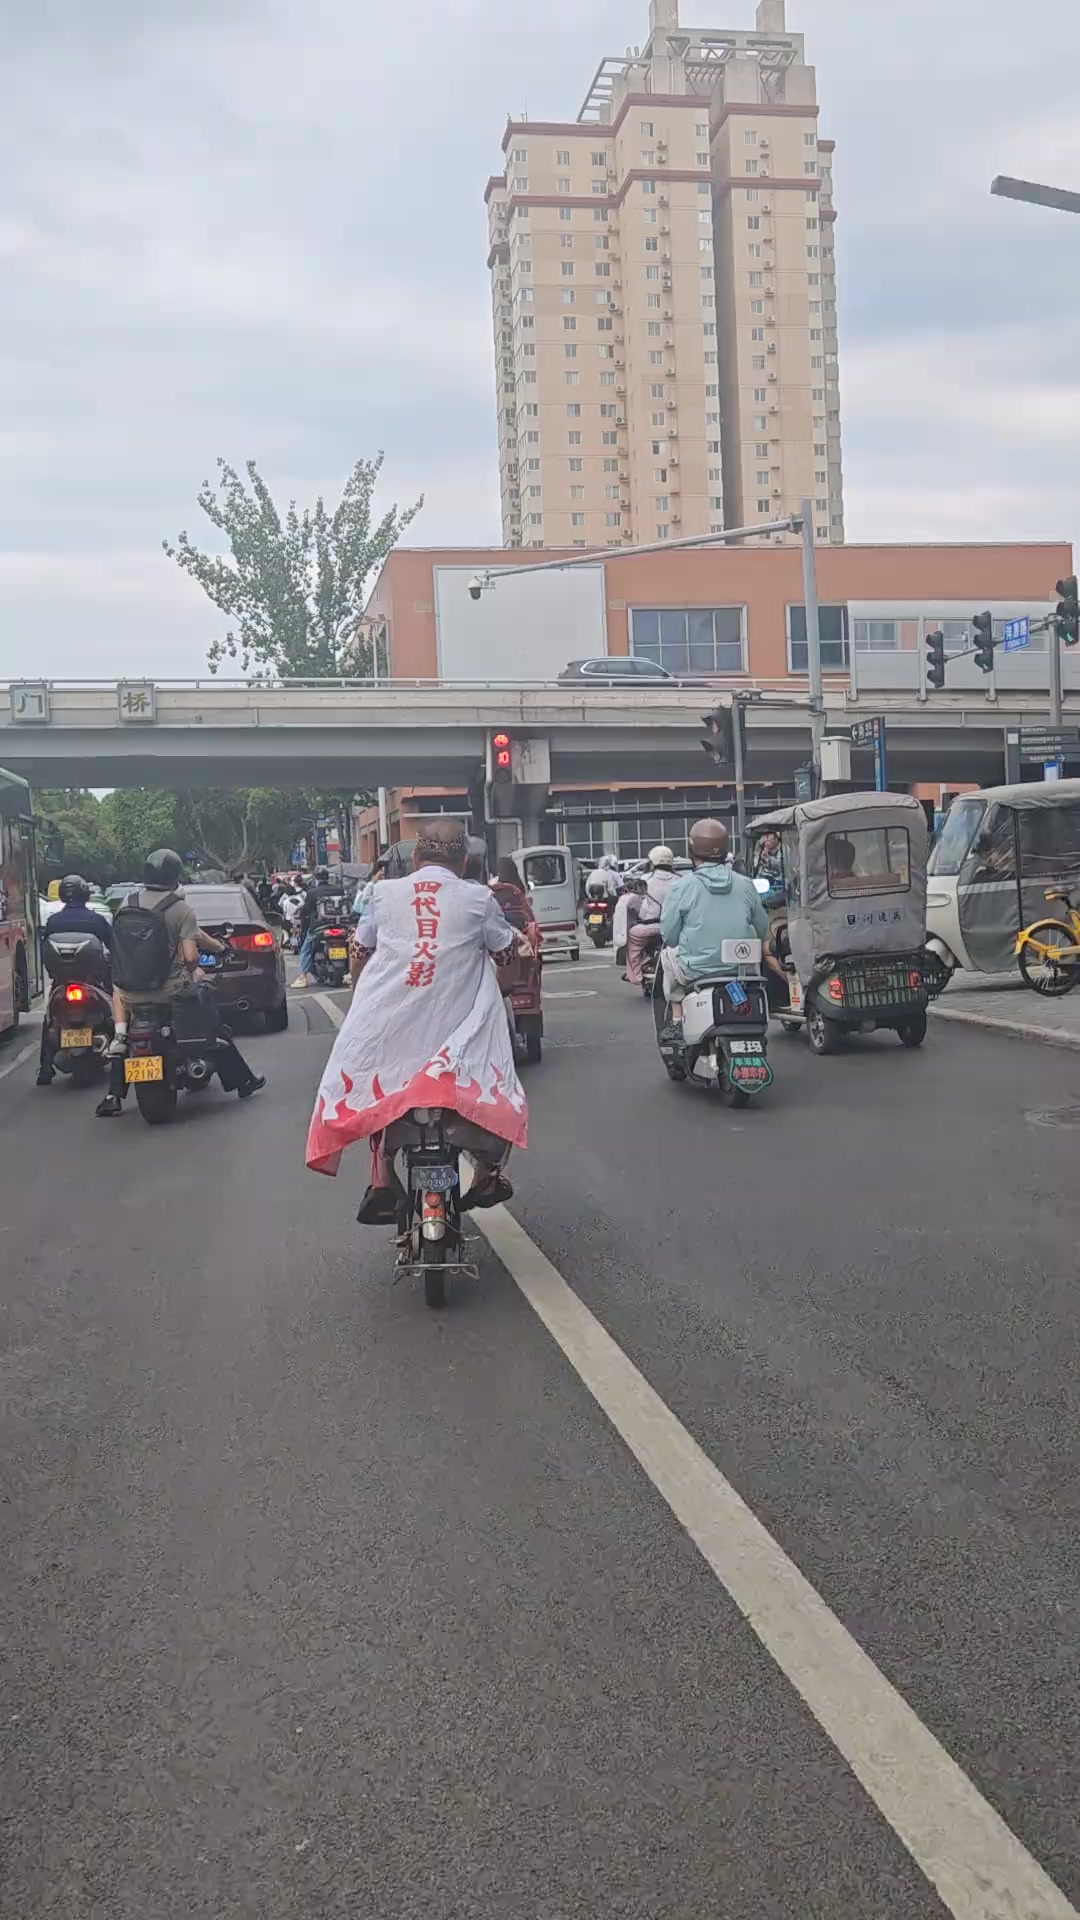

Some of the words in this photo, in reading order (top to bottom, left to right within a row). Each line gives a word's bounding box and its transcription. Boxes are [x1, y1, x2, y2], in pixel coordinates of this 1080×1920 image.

[405, 881, 442, 987] 四代目火影
[730, 1041, 762, 1053] 爱玛
